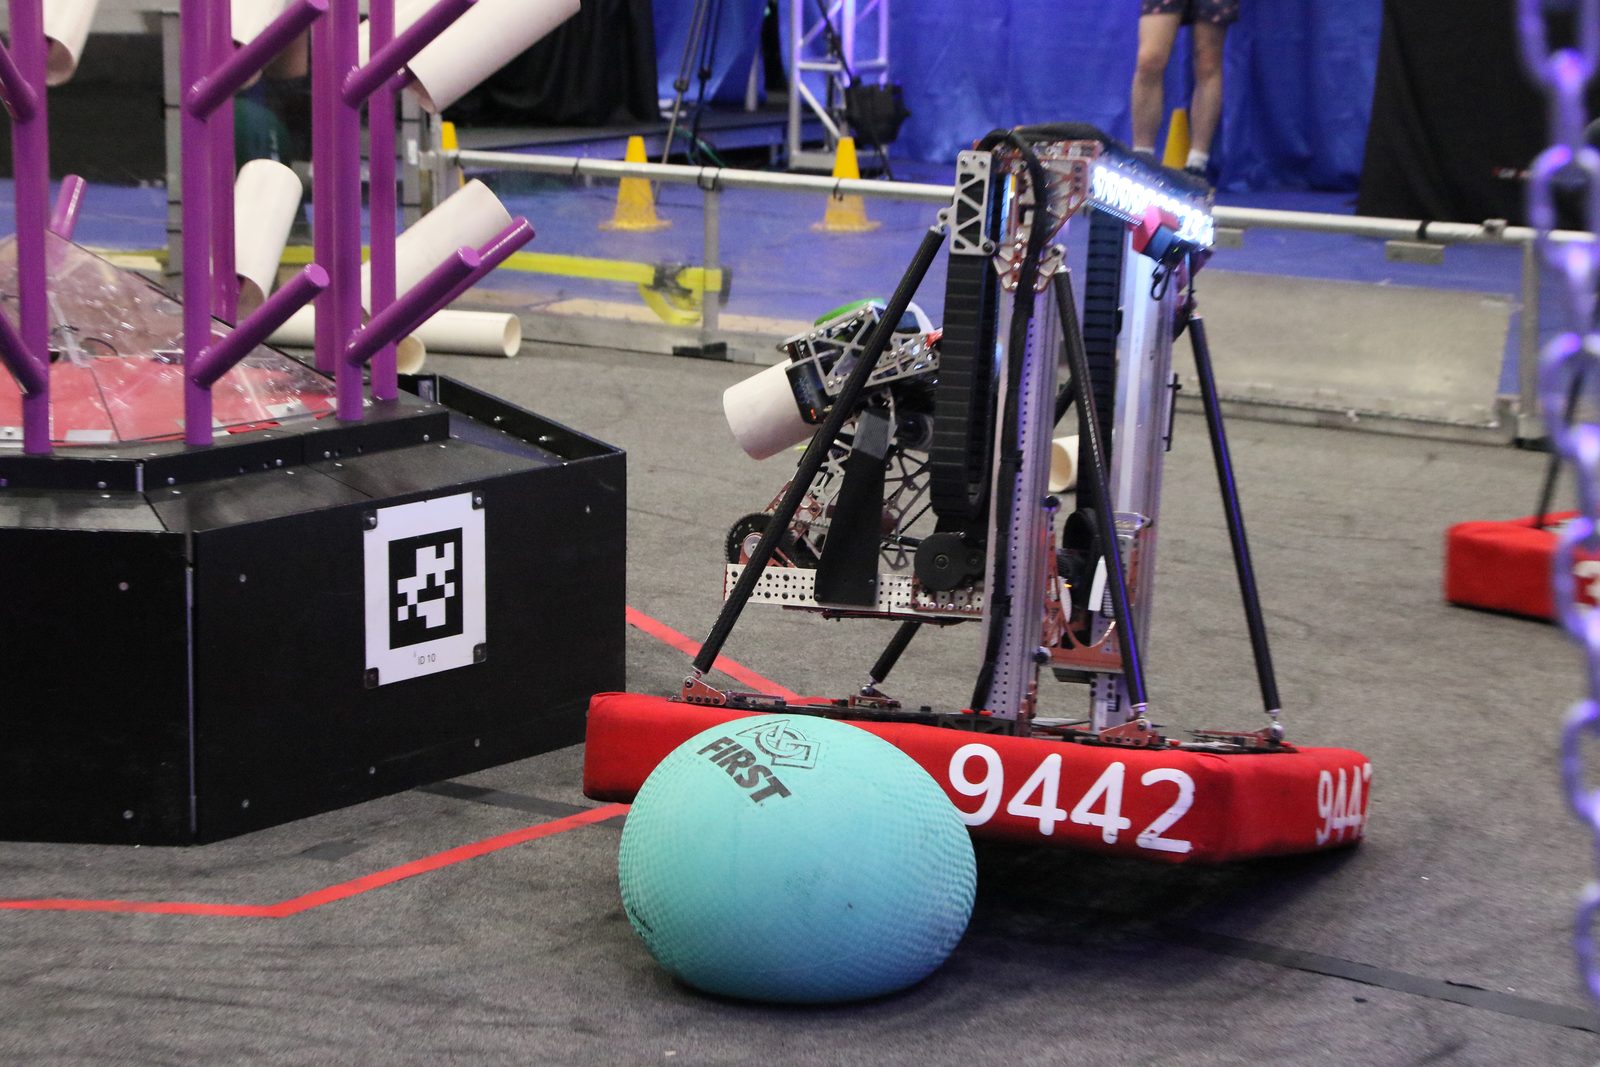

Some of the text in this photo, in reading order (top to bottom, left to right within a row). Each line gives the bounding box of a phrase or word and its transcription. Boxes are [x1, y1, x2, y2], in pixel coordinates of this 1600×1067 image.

[427, 653, 436, 663] 10
[696, 736, 792, 803] FIRST
[948, 743, 1195, 853] 9442
